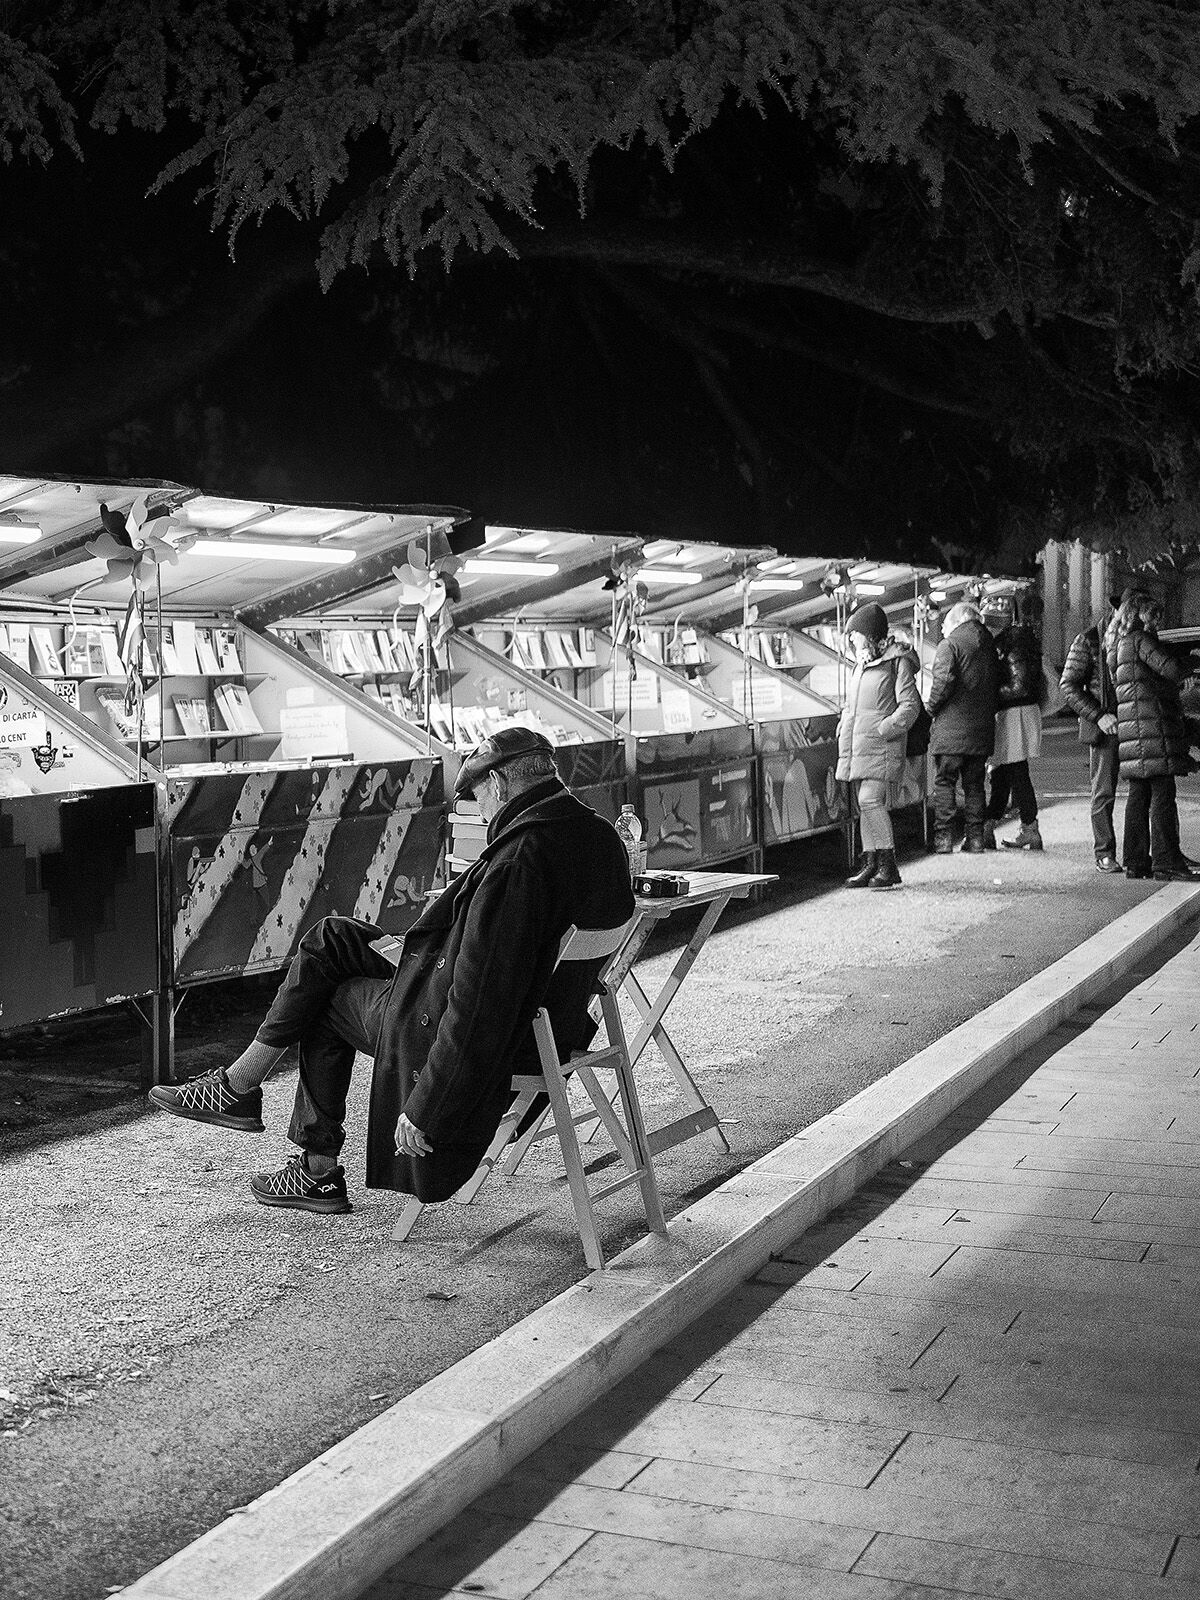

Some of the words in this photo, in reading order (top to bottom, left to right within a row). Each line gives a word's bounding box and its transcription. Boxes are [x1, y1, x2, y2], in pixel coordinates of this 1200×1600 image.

[2, 714, 11, 723] DI
[12, 711, 38, 722] CARTA
[7, 732, 27, 743] CENT
